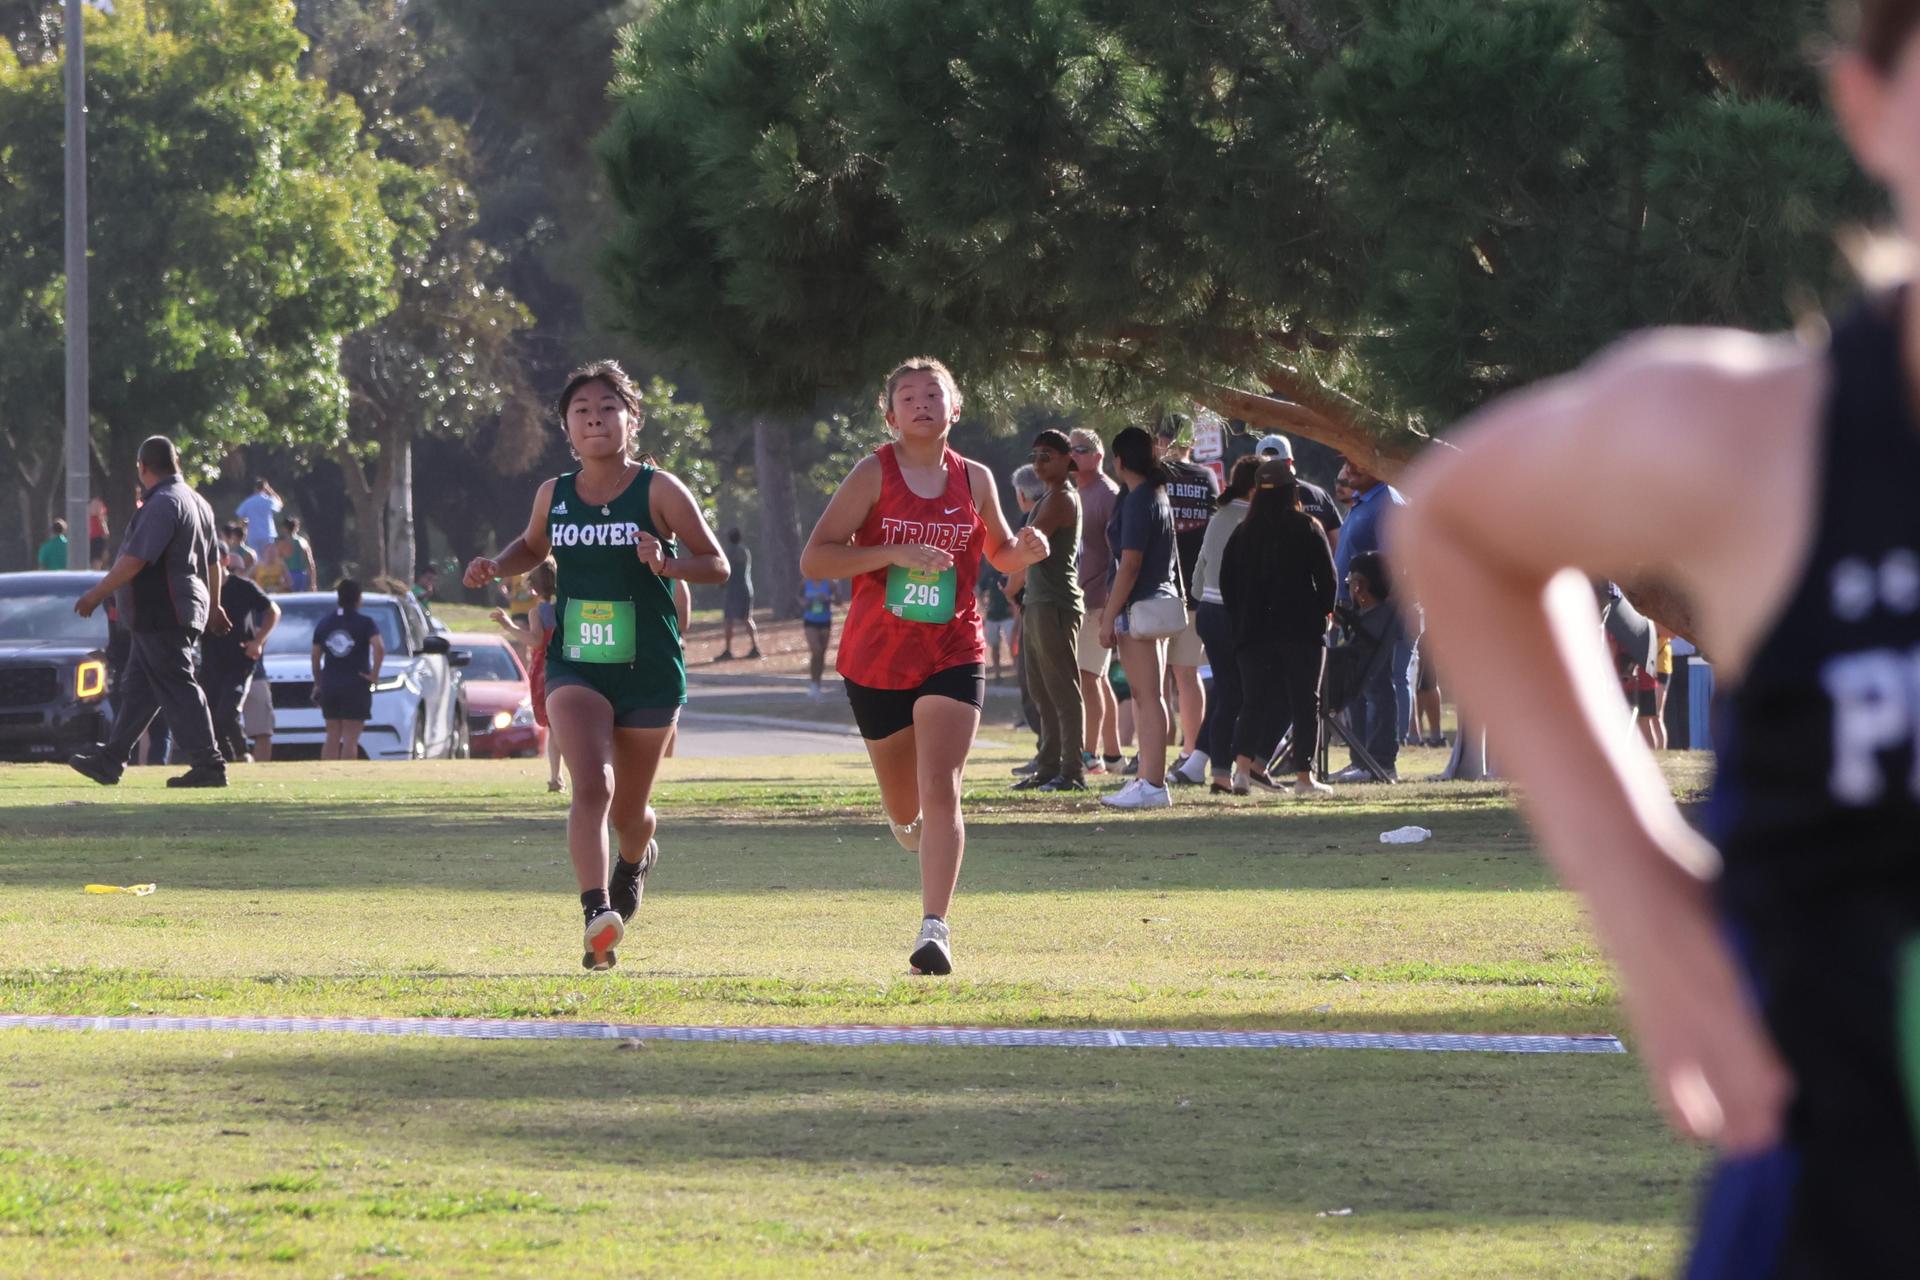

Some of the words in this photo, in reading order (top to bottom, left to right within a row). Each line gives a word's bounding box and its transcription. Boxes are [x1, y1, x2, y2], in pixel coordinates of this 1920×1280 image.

[1176, 484, 1208, 500] RIGHT
[1181, 508, 1192, 519] SO
[552, 523, 640, 546] HOOVER
[882, 518, 973, 552] TRIBE
[903, 583, 939, 607] 296
[580, 622, 615, 646] 991
